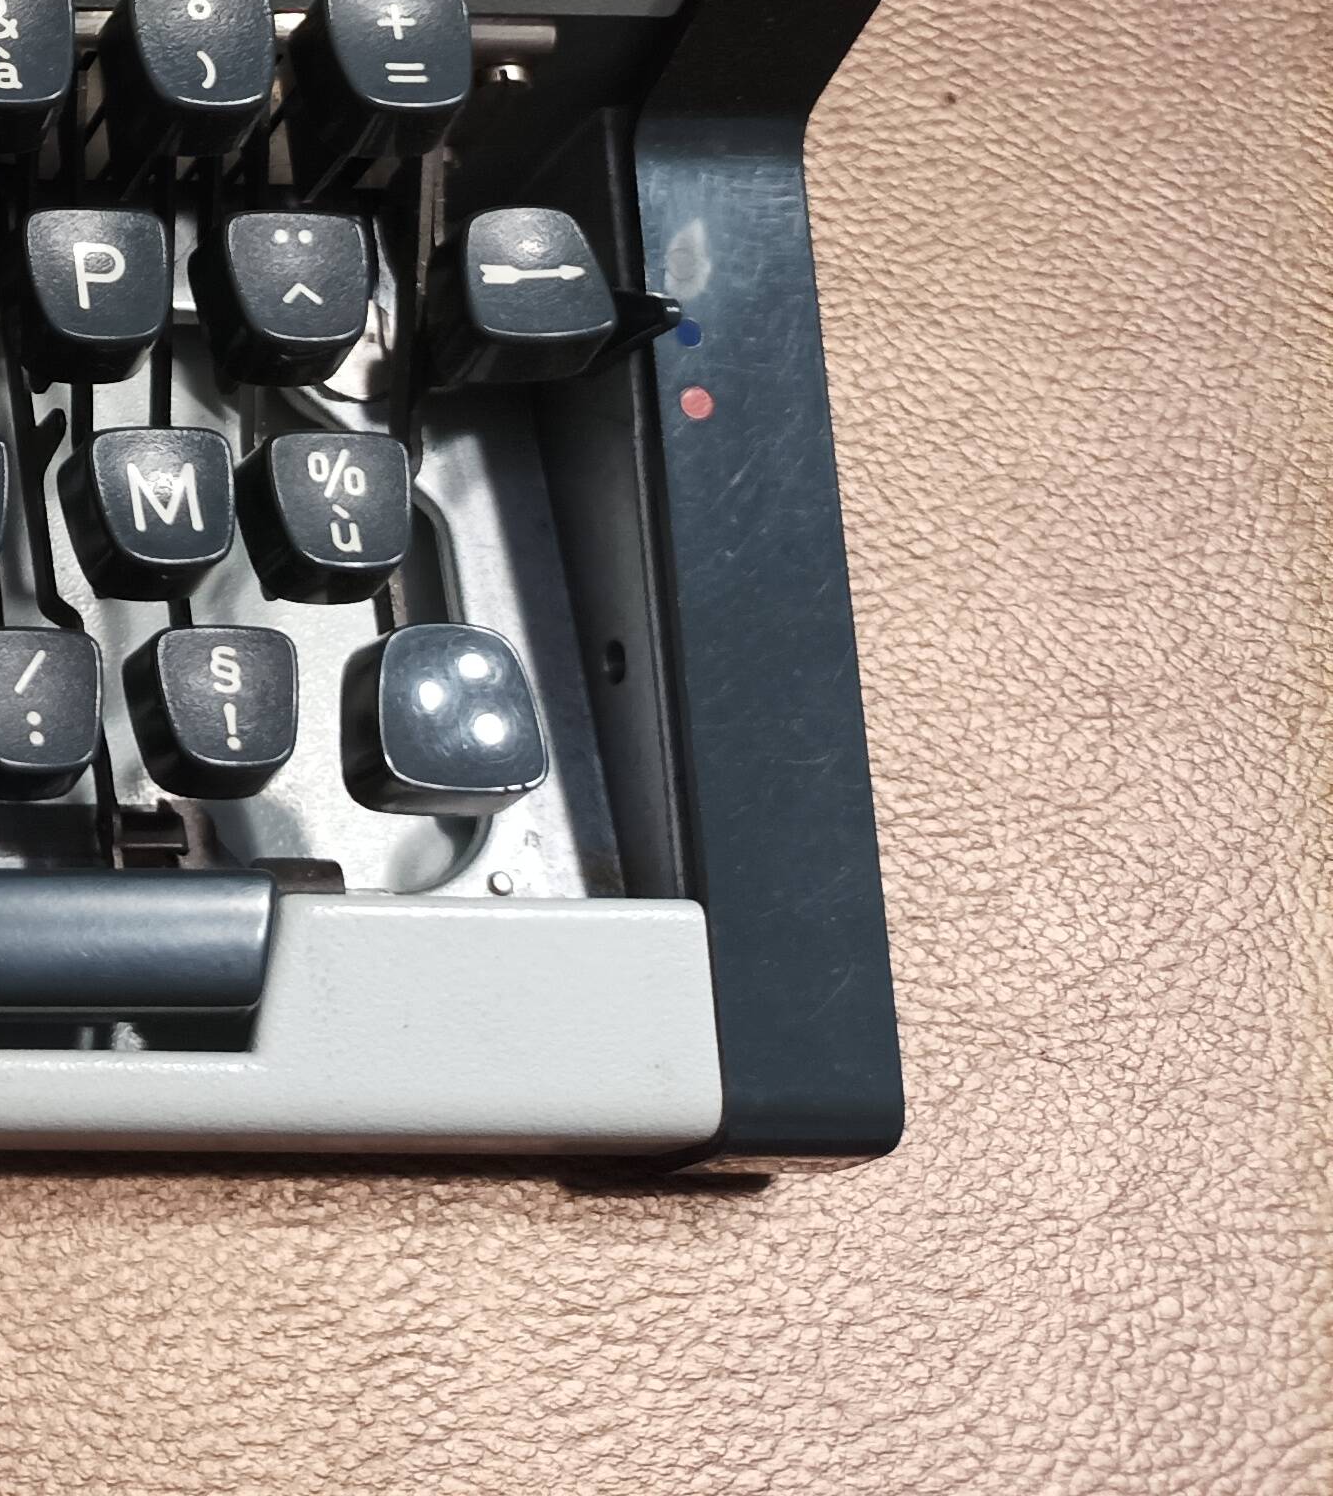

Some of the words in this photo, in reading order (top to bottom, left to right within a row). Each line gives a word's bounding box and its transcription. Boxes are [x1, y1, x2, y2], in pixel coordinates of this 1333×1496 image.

[72, 241, 126, 310] P
[125, 462, 204, 532] M
[307, 448, 366, 498] %
[330, 503, 363, 553] ù
